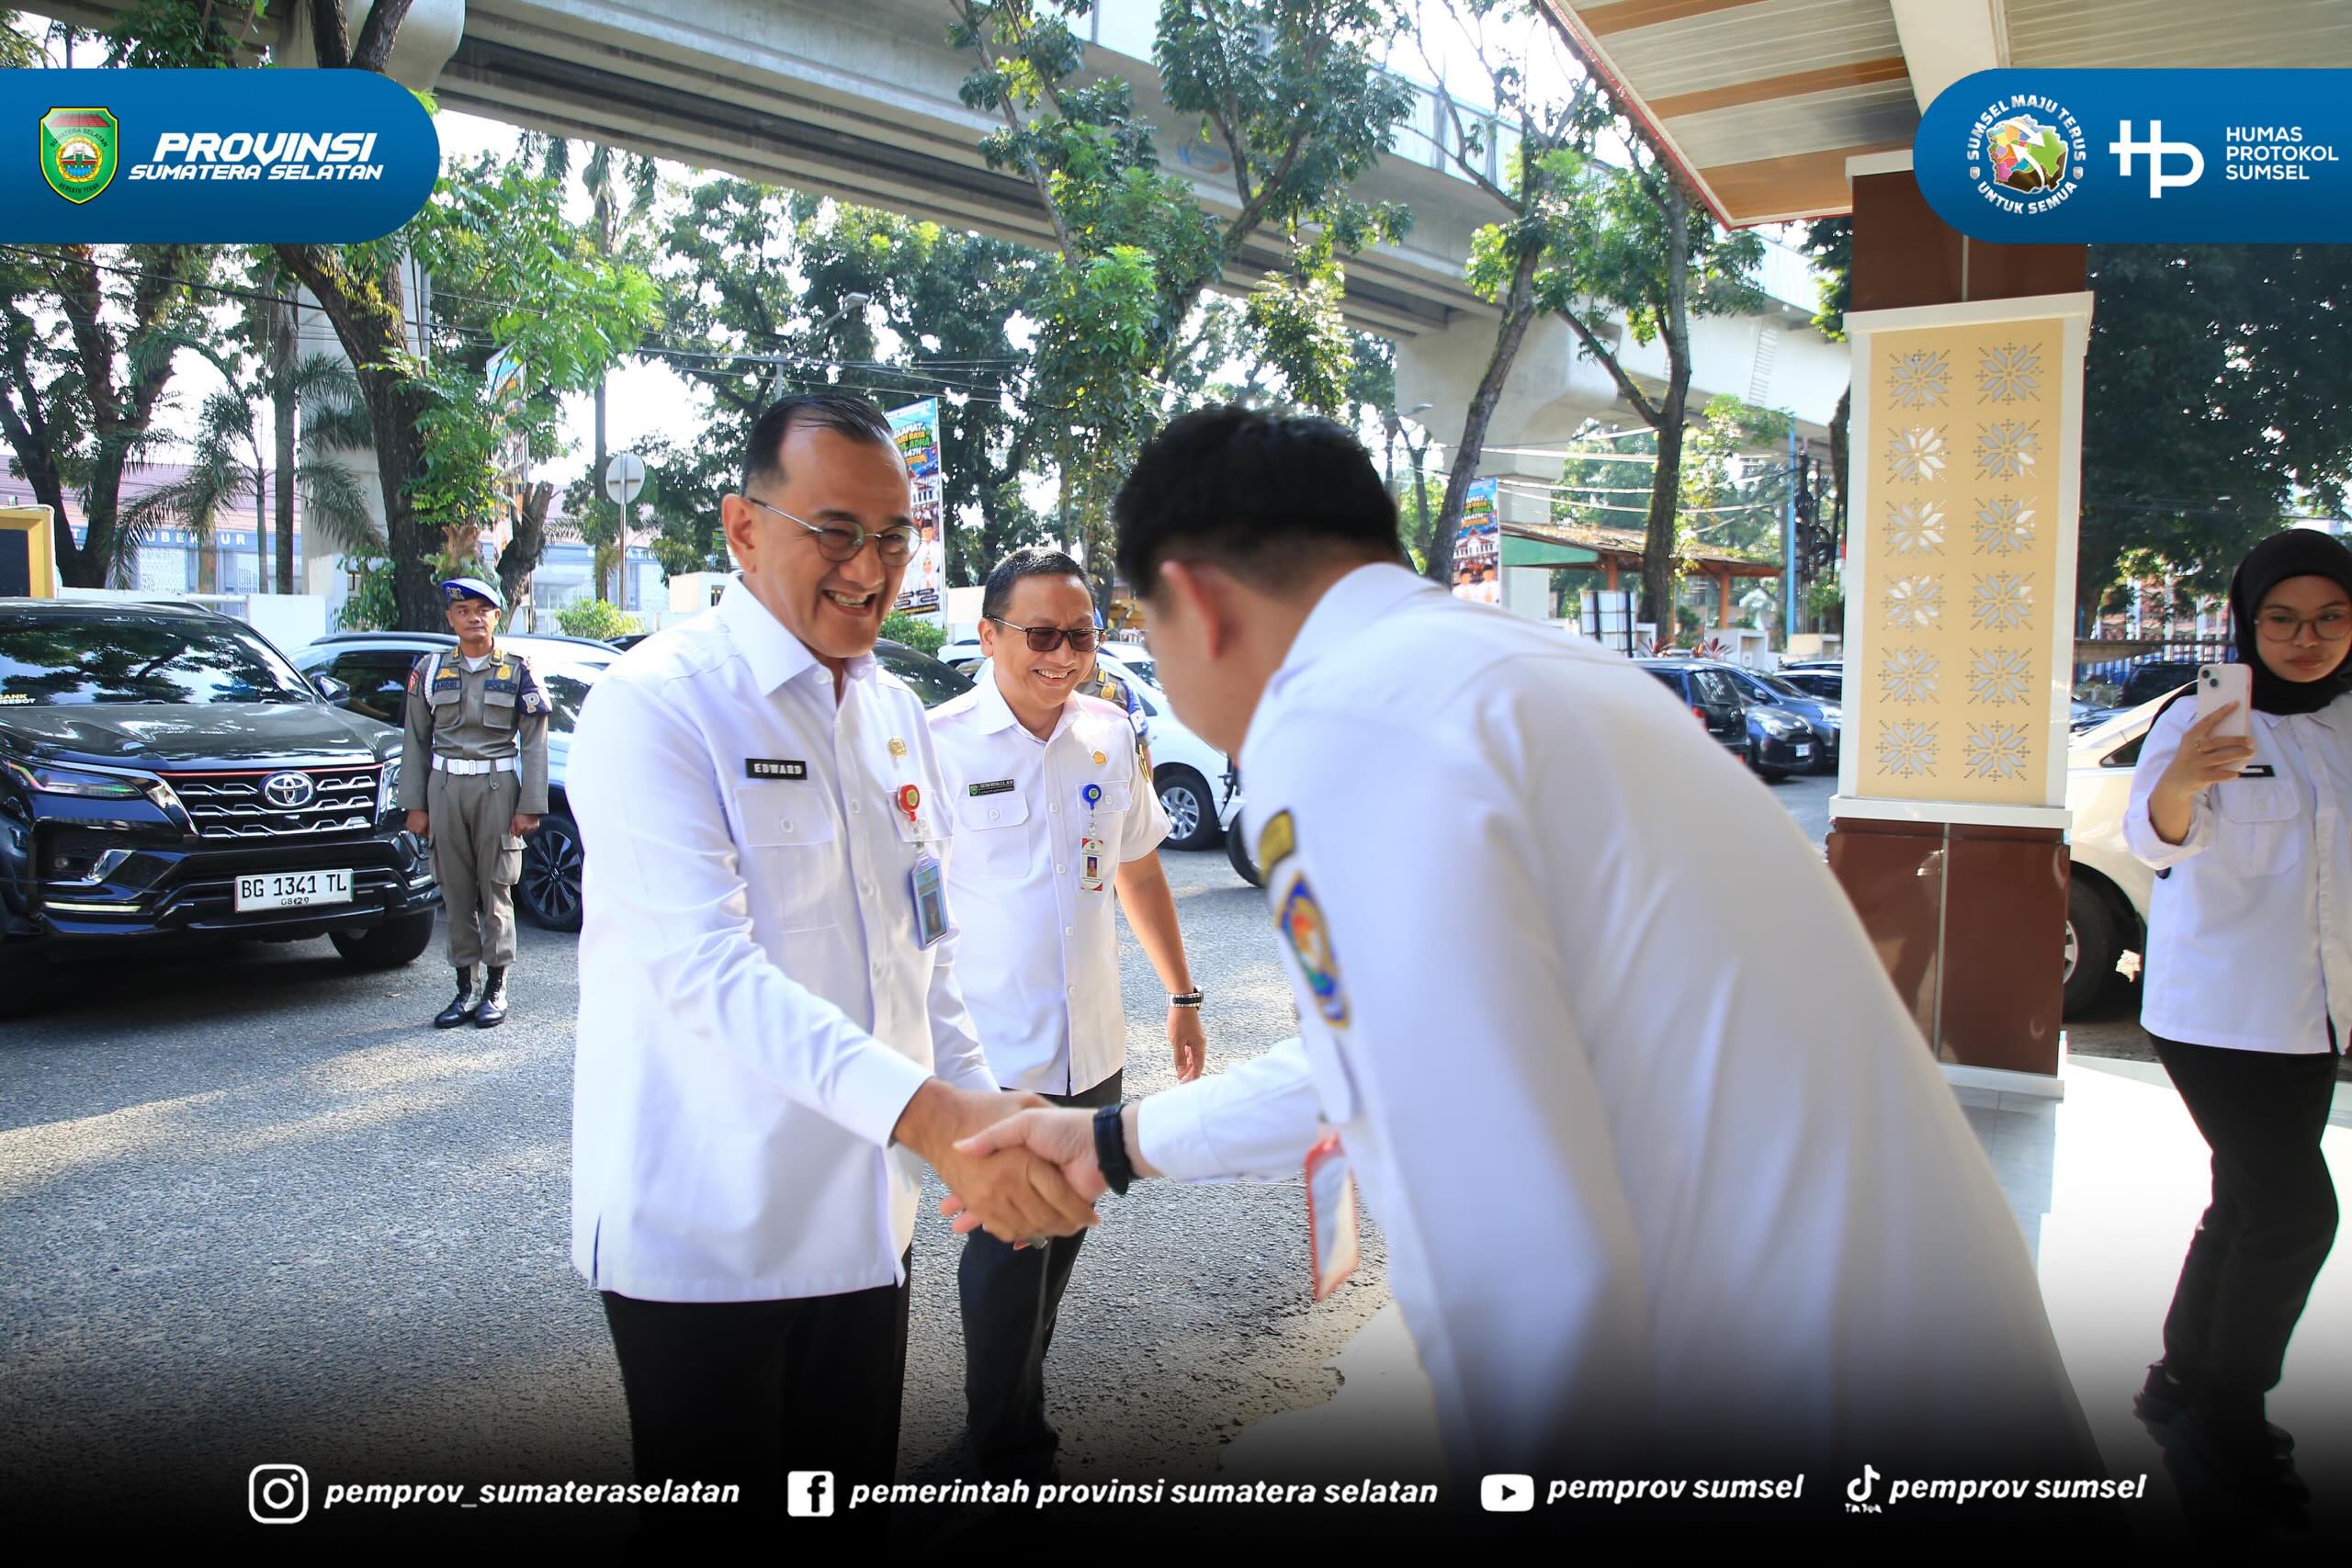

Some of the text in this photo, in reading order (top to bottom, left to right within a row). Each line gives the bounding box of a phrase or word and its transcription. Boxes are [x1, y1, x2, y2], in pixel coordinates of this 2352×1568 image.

[753, 763, 802, 774] EDWARD
[242, 874, 347, 898] BG 1341 TL
